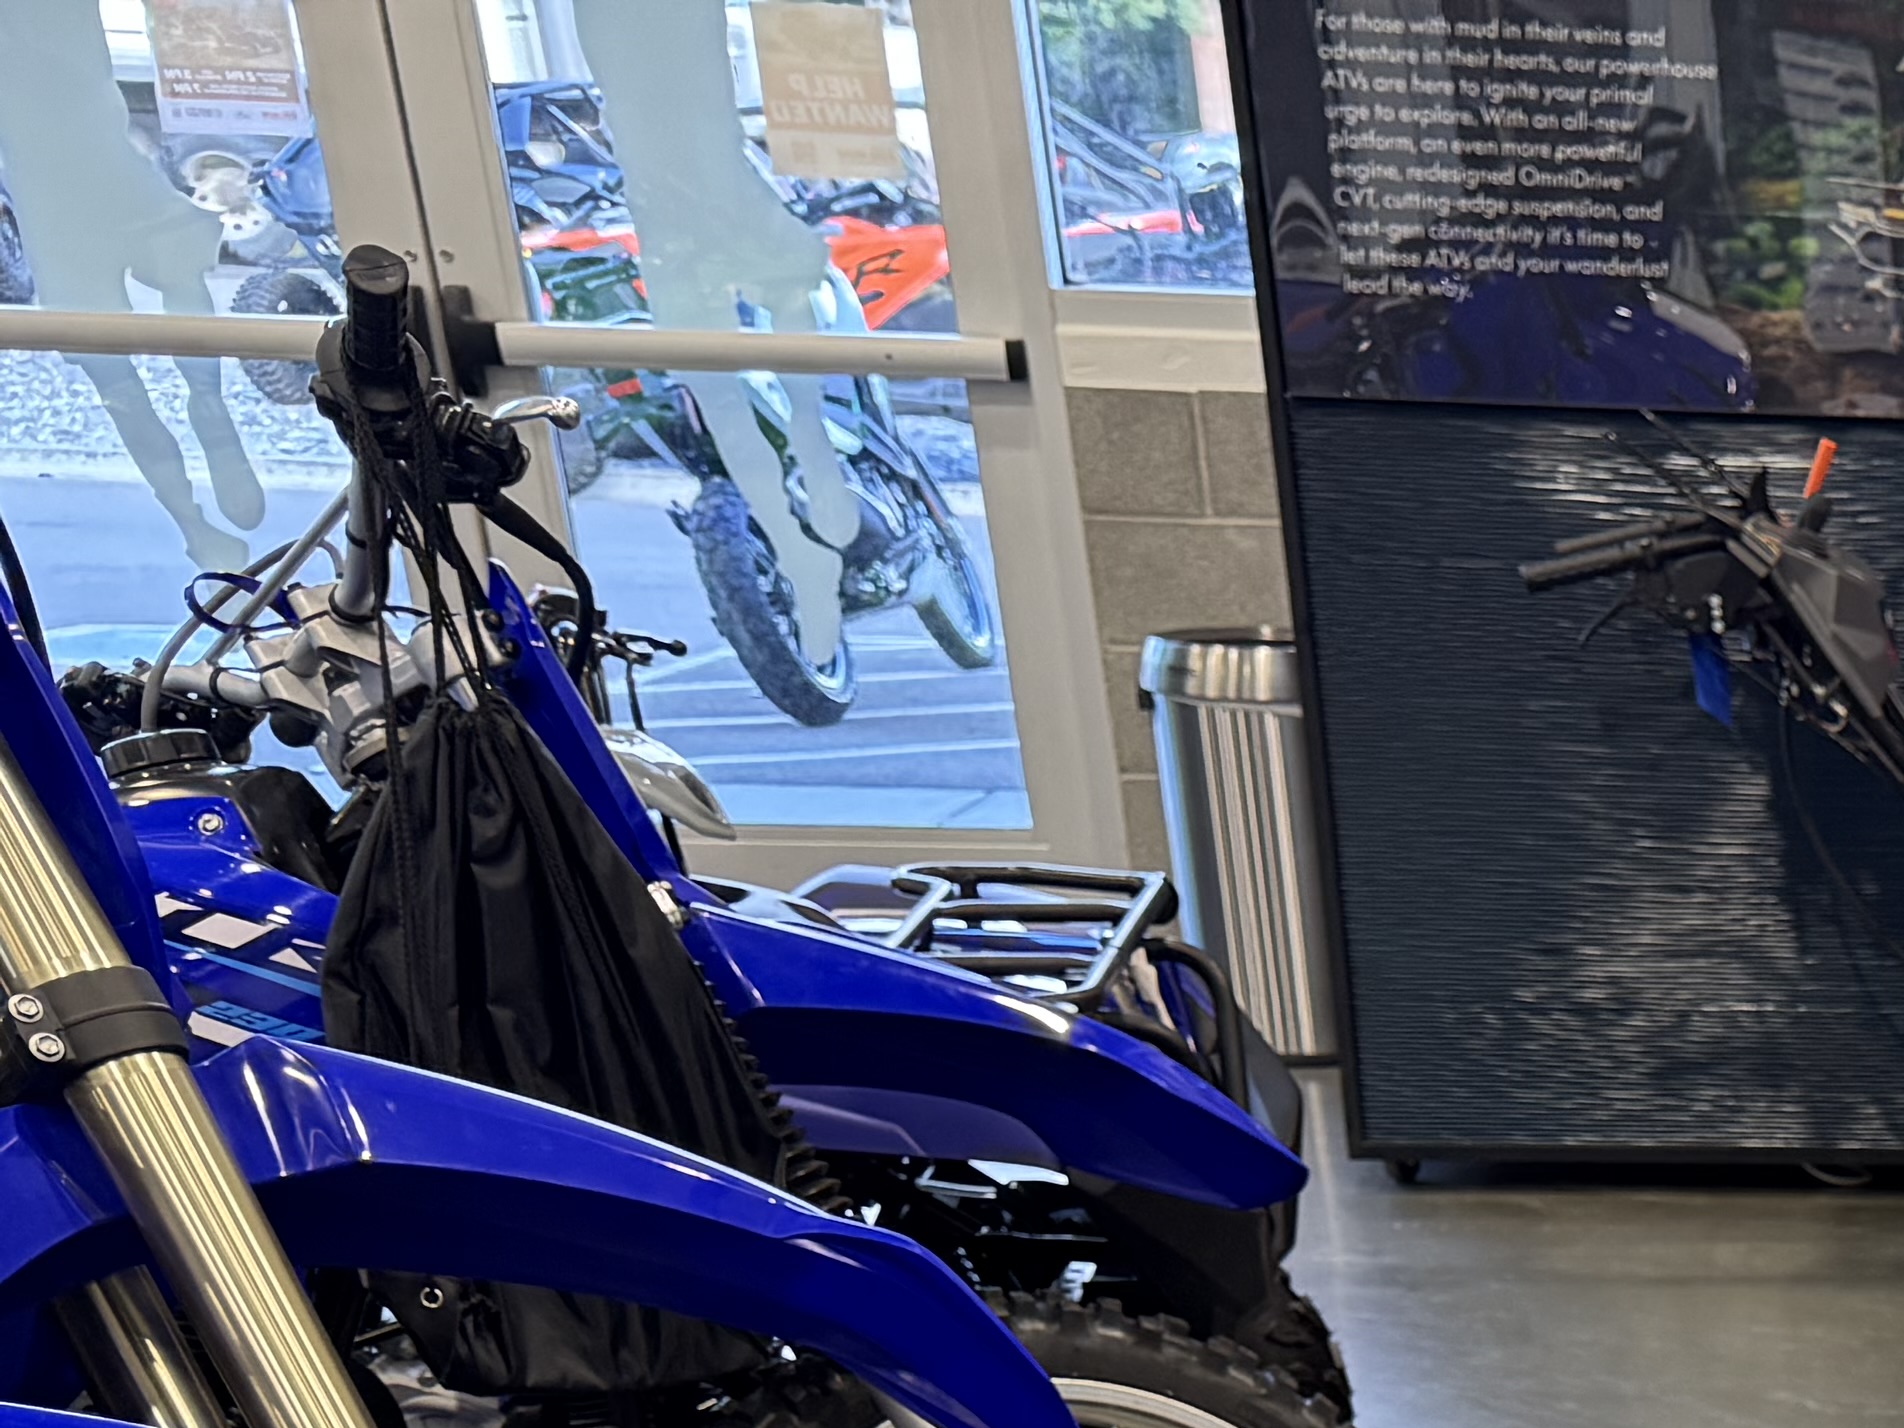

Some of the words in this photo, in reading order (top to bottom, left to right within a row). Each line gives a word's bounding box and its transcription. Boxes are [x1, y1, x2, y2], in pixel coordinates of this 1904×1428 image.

[1315, 9, 1347, 31] For
[1351, 11, 1405, 34] those
[1408, 15, 1451, 36] with
[1454, 18, 1499, 39] mud
[1502, 18, 1521, 39] in
[1524, 19, 1569, 42] their
[1573, 25, 1623, 46] veins
[1625, 26, 1666, 48] and
[1317, 39, 1420, 65] adventure
[1422, 46, 1442, 65] in
[1445, 46, 1489, 68] their
[1493, 48, 1560, 73] hearts,
[1562, 56, 1596, 73] our
[1599, 55, 1718, 80] powerhouse
[1321, 68, 1369, 92] ATVs
[1371, 77, 1408, 93] are
[1410, 71, 1455, 96] here
[1458, 77, 1481, 97] to
[1483, 77, 1540, 104] ignite
[1542, 86, 1586, 106] your
[1589, 84, 1653, 109] primal
[1324, 105, 1371, 126] urge
[1374, 102, 1395, 122] to
[1399, 104, 1478, 129] explore.
[1479, 105, 1529, 129] With
[1531, 113, 1559, 130] an
[1561, 108, 1637, 133] all-new
[1327, 129, 1418, 155] platform,
[1420, 139, 1447, 154] an
[1451, 139, 1498, 156] even
[1501, 141, 1550, 159] more
[1554, 142, 1642, 165] powerful
[1330, 160, 1402, 184] engine,
[1406, 160, 1515, 190] redesigned
[1382, 191, 1509, 219] cutting-edge
[1511, 199, 1621, 222] suspension,
[1622, 201, 1663, 222] and
[1337, 221, 1425, 244] next-gen
[1428, 222, 1545, 249] connectivity
[1577, 227, 1619, 247] time
[1622, 230, 1644, 249] to
[1339, 245, 1366, 265] let
[1369, 245, 1422, 268] these
[1423, 249, 1472, 270] ATVs
[1474, 252, 1514, 272] and
[1516, 259, 1560, 278] your
[1563, 255, 1669, 278] wanderlust
[1343, 272, 1389, 295] lead
[1391, 274, 1424, 296] the
[1427, 280, 1474, 303] way.
